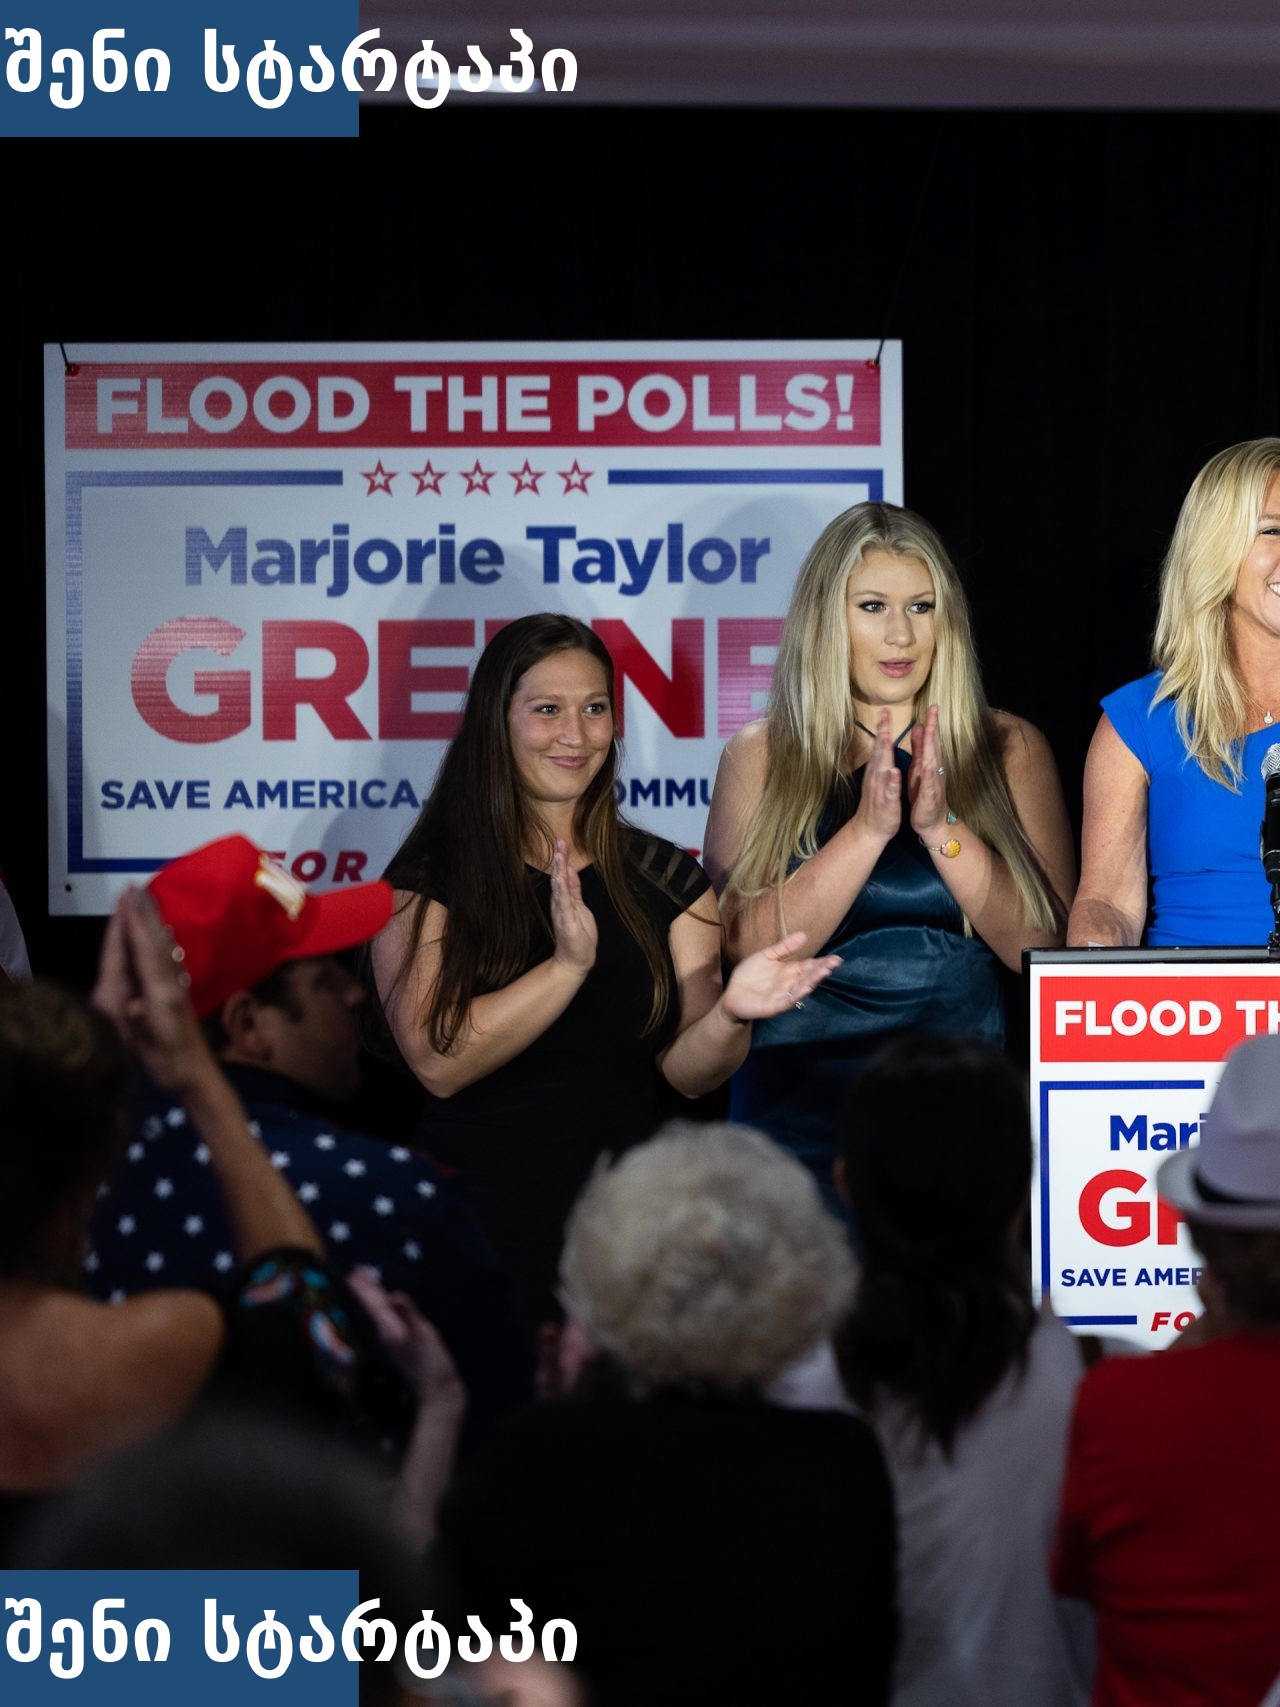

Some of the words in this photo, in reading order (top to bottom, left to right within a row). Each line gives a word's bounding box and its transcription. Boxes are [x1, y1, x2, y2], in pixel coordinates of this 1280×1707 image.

[96, 376, 370, 434] FLOOD
[394, 375, 552, 432] THE
[577, 373, 856, 432] POLLS!
[186, 522, 504, 598] Marjorie
[525, 522, 772, 597] Taylor
[131, 615, 786, 744] GRENE
[101, 779, 211, 810] SAVE
[1055, 999, 1222, 1037] FLOOD
[1060, 1267, 1127, 1288] SAVE
[1151, 1311, 1197, 1332] FO
